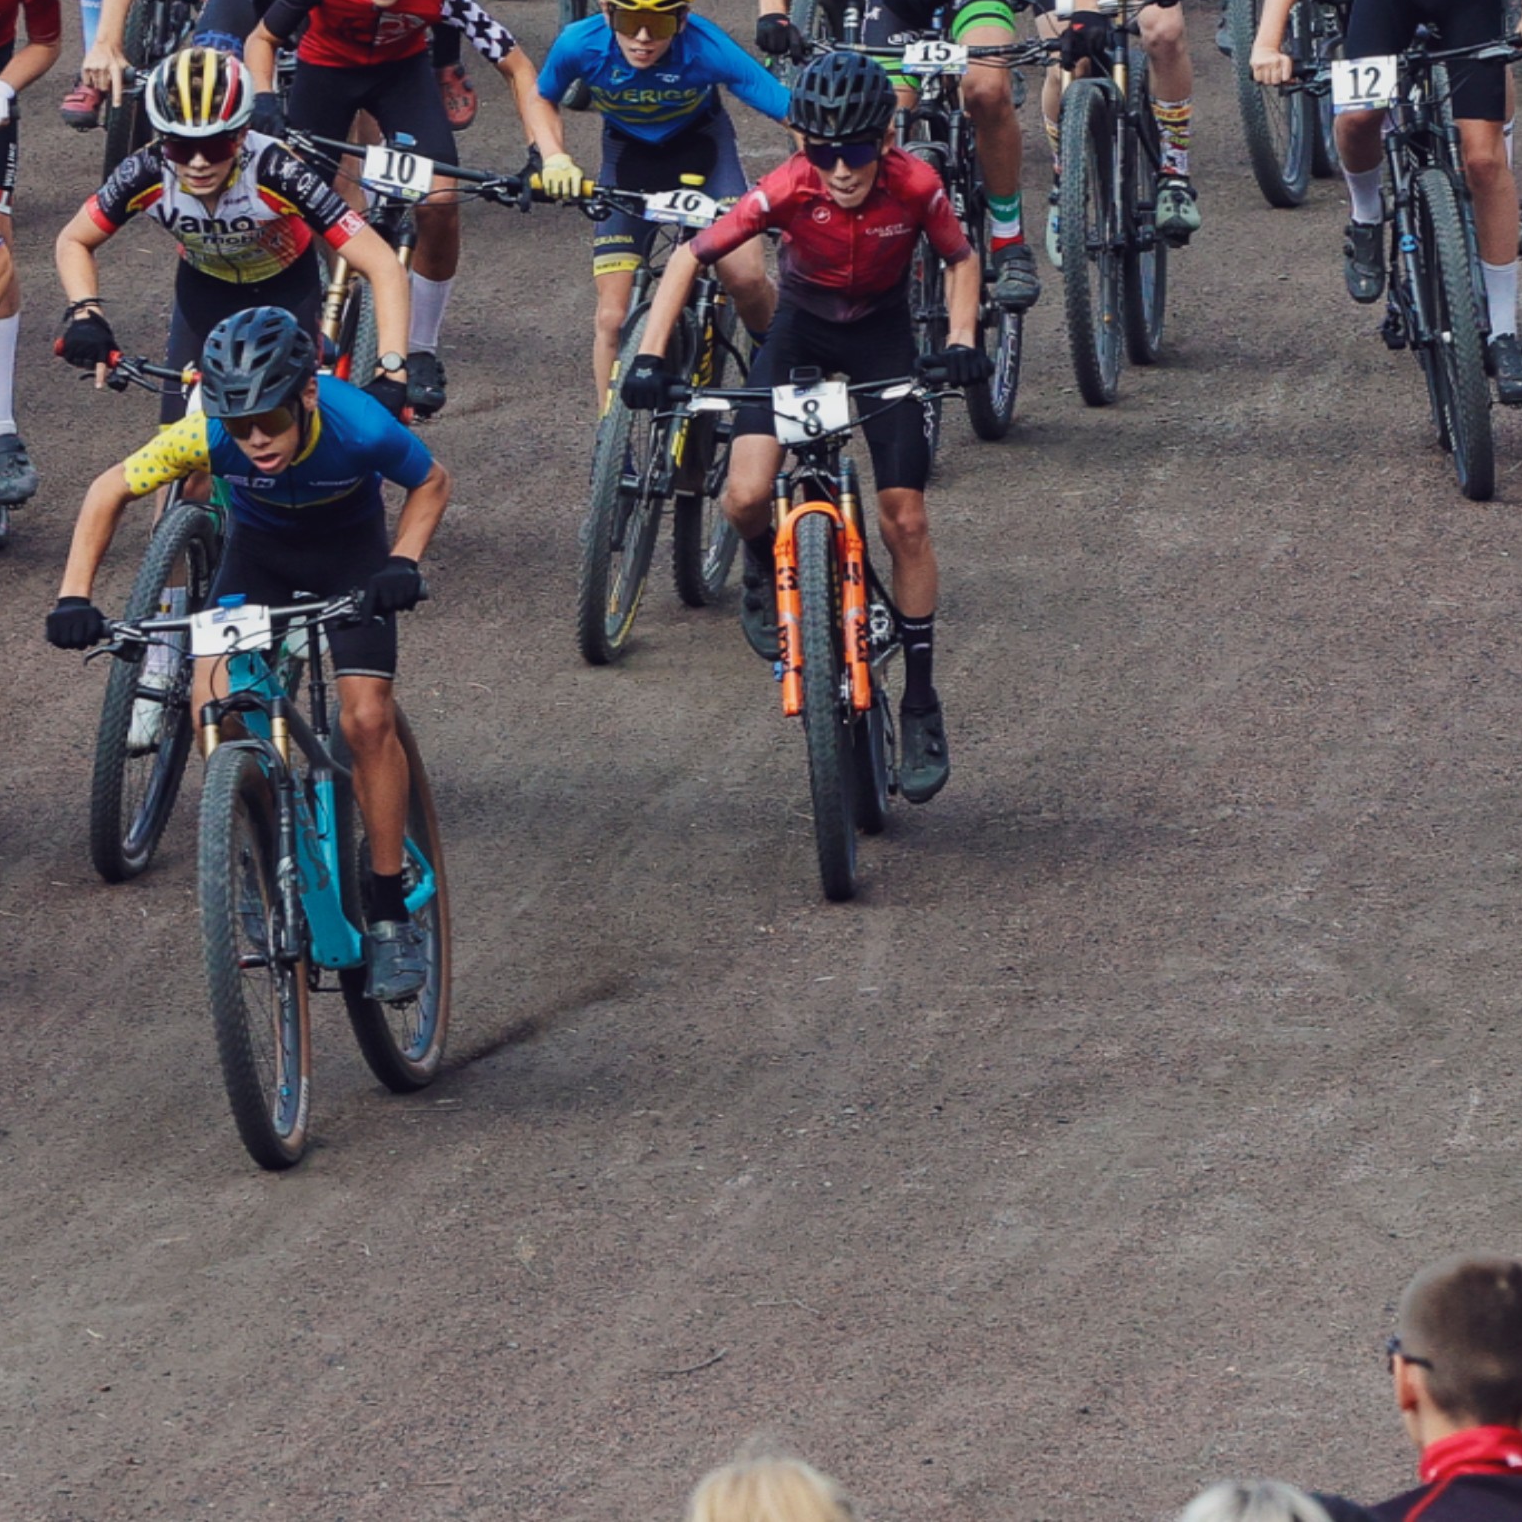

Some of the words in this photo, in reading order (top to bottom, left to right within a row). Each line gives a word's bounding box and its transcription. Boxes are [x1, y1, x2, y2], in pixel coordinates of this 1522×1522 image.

[919, 43, 952, 61] 15
[1347, 65, 1382, 100] 12
[382, 151, 417, 183] 10
[664, 191, 702, 212] 16
[802, 398, 823, 437] 8
